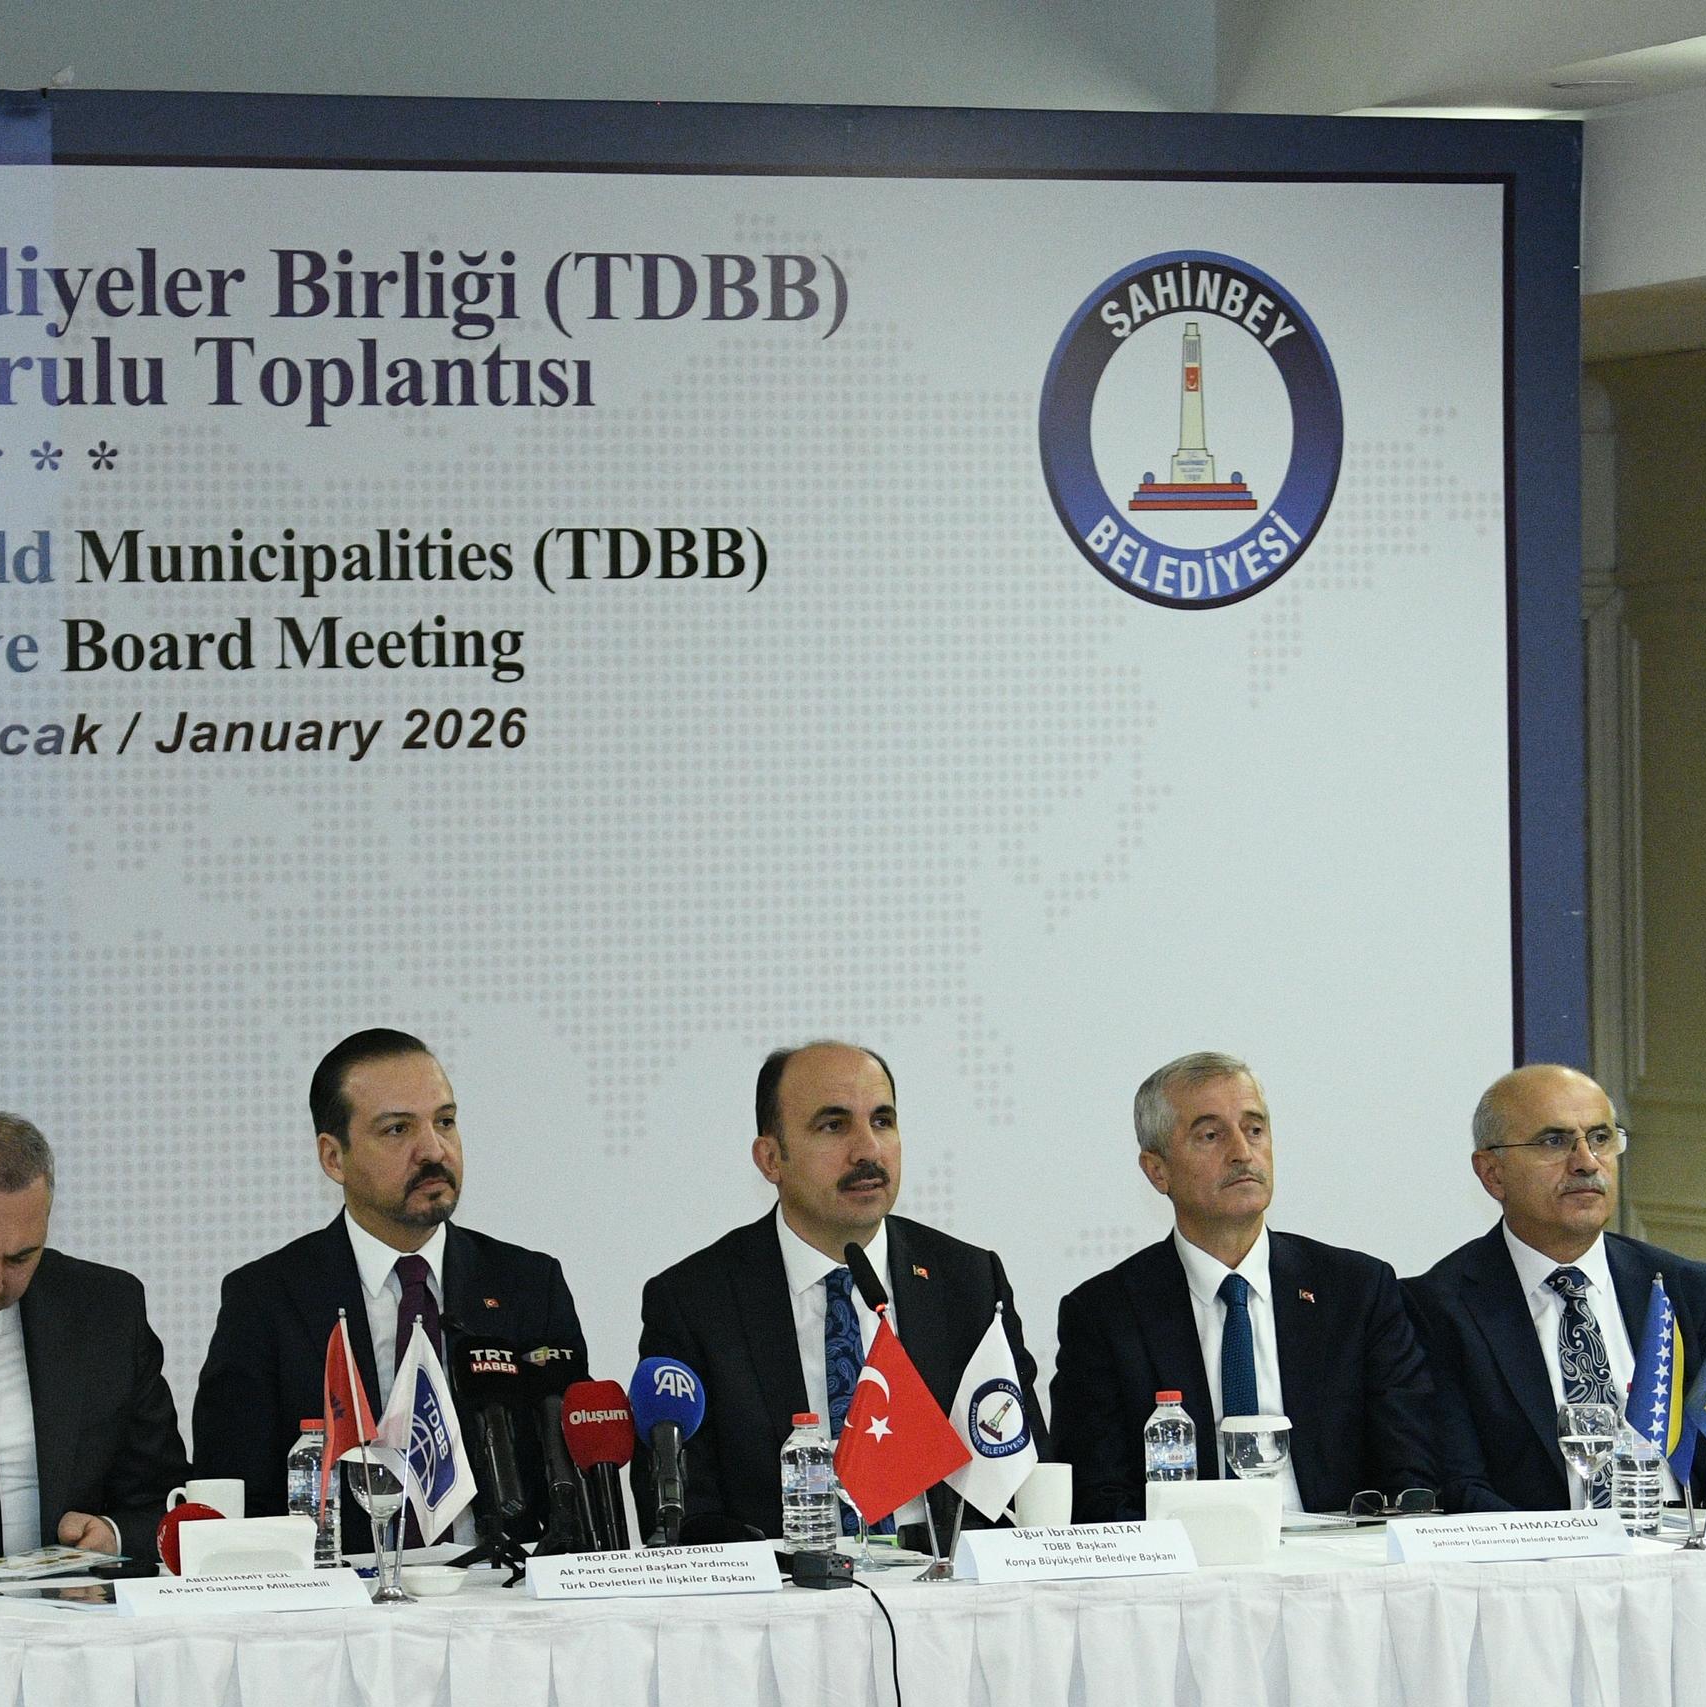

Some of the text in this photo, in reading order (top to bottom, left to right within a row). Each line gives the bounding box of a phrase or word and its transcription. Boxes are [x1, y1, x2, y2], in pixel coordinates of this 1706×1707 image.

[269, 248, 520, 341] Birliği
[545, 250, 849, 340] (TDBB)
[1101, 262, 1296, 348] ŞAHİNBEY
[195, 337, 595, 428] Toplantısı
[75, 527, 514, 598] Municipalities
[534, 527, 769, 594] (TDBB)
[1084, 510, 1302, 599] BELEDİYESİ
[62, 617, 255, 672] Board
[276, 615, 524, 683] Meeting
[155, 711, 382, 762] January
[402, 708, 527, 750] 2026
[470, 1350, 513, 1362] TRT
[530, 1349, 574, 1361] GRT
[473, 1361, 518, 1374] HABER
[655, 1371, 696, 1402] AA
[569, 1408, 629, 1425] Oluşum
[423, 1393, 449, 1460] TDBB
[1012, 1524, 1142, 1540] Uğur İbrahim ALTAY
[1416, 1517, 1599, 1536] Mehmet İhsan TAHMAZOĞLU
[1043, 1541, 1117, 1551] TDBB Başkanı
[1521, 1535, 1556, 1544] Belediye
[1558, 1533, 1589, 1542] Başkanı
[577, 1552, 632, 1563] PROF.DR.
[686, 1545, 725, 1556] ZORLU
[1005, 1552, 1177, 1568] Konya Büyükşehir Belediye Başkanı
[267, 1571, 291, 1580] GÜL
[559, 1559, 749, 1576] Ak Parti Genel Başkan Yardımcısı
[159, 1580, 331, 1596] Ak Parti Gaziantep Milletvekili
[560, 1573, 756, 1590] Türk Devletleri ile İlişkiler Başkanı
